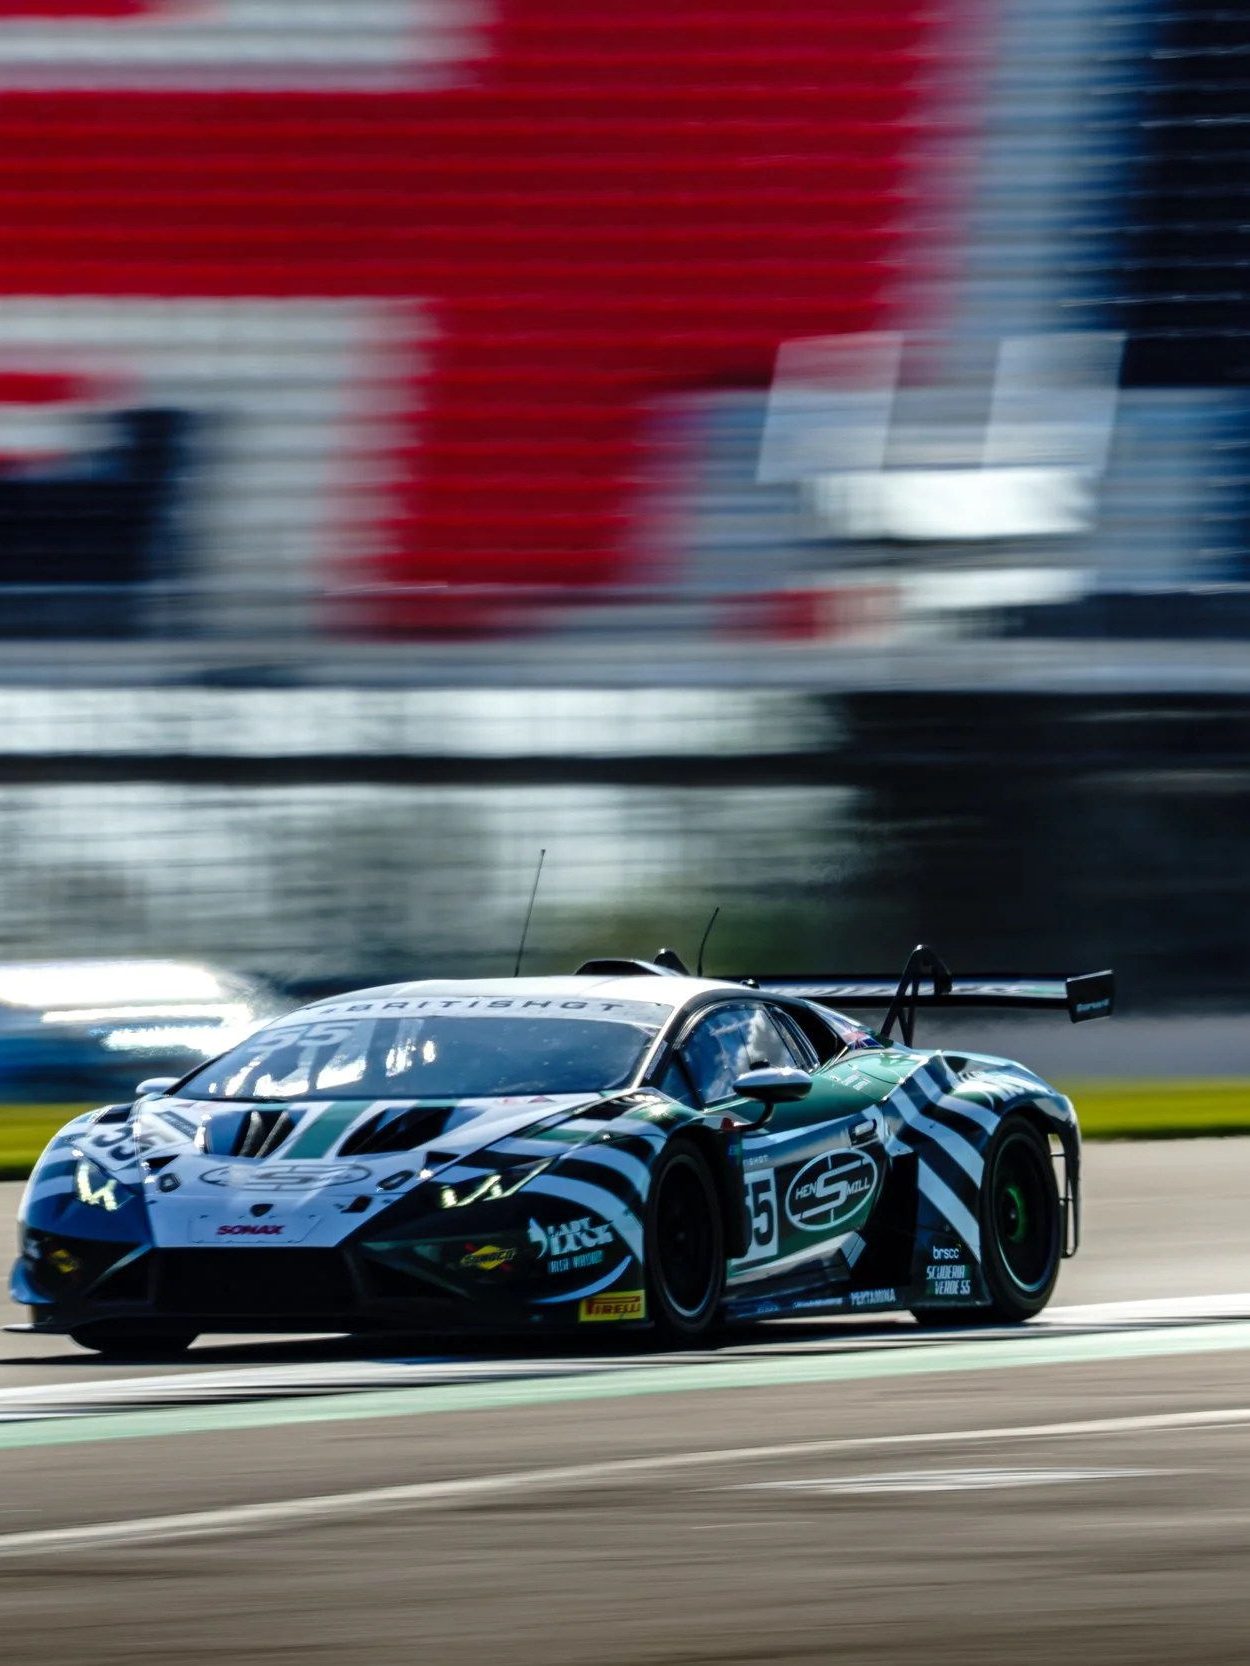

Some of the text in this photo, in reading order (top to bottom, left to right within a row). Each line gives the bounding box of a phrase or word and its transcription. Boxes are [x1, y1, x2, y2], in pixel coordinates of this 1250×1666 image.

[795, 1182, 818, 1200] HEN
[846, 1176, 871, 1196] MILL
[215, 1224, 285, 1236] SONAX
[932, 1244, 960, 1260] brscc
[925, 1264, 966, 1280] SCUDERIA
[585, 1295, 642, 1316] PIRELLI
